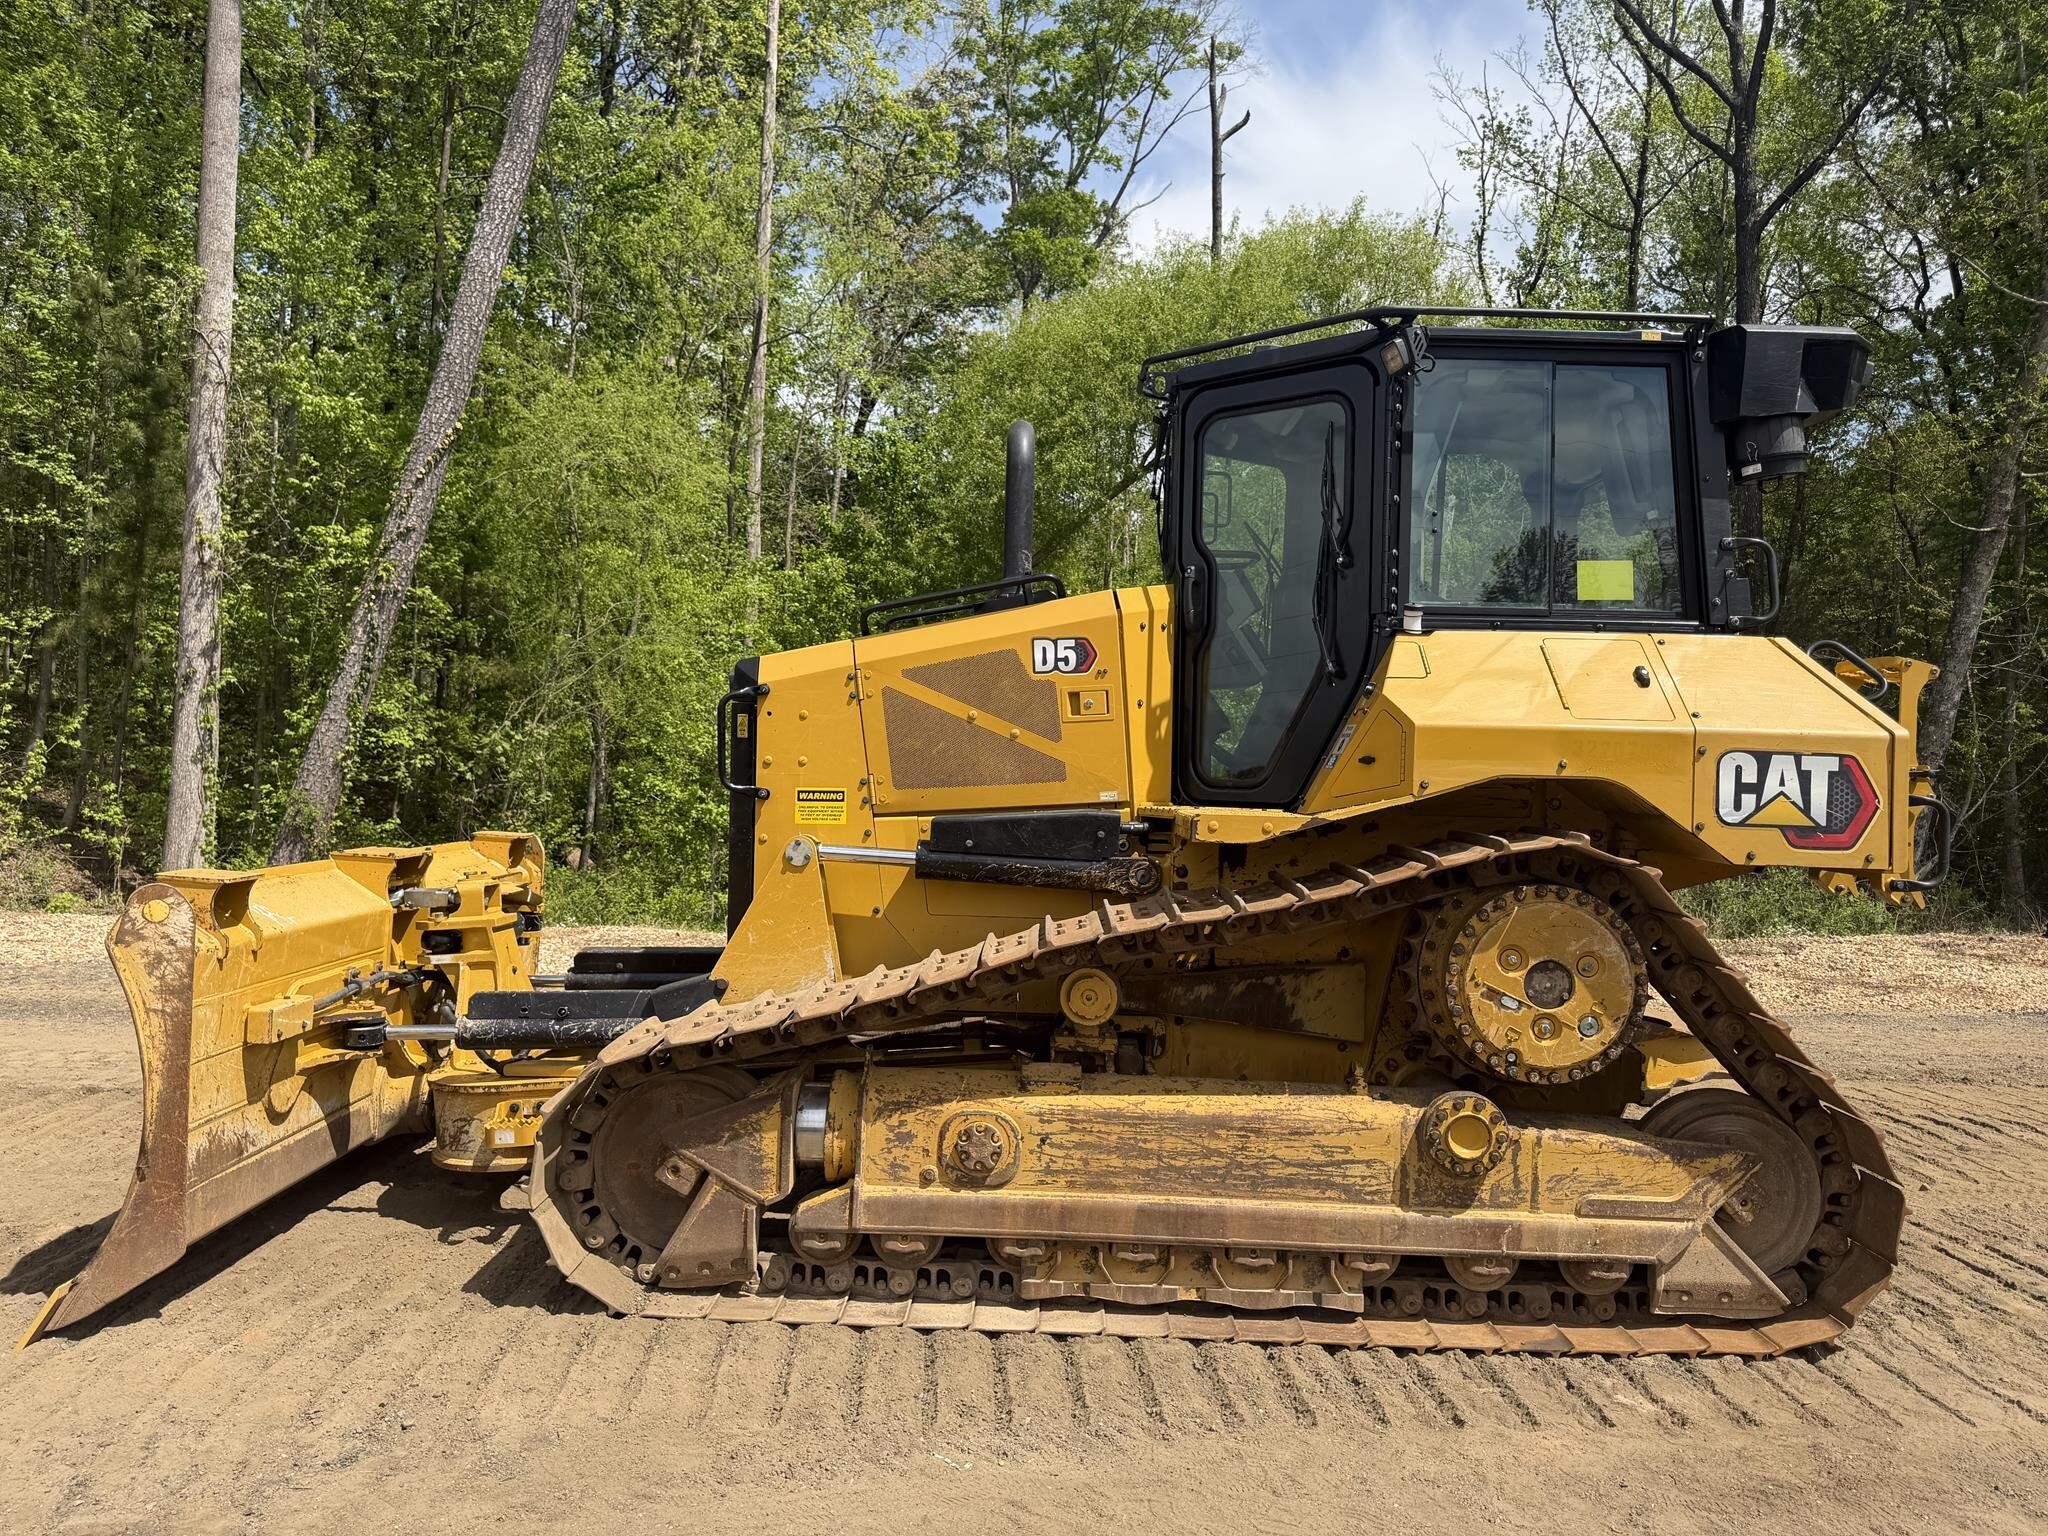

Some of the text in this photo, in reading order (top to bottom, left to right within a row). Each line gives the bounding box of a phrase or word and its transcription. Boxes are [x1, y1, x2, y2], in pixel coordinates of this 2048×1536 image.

[1033, 639, 1077, 673] D5
[799, 792, 844, 800] WARNING
[1718, 751, 1840, 827] CAT
